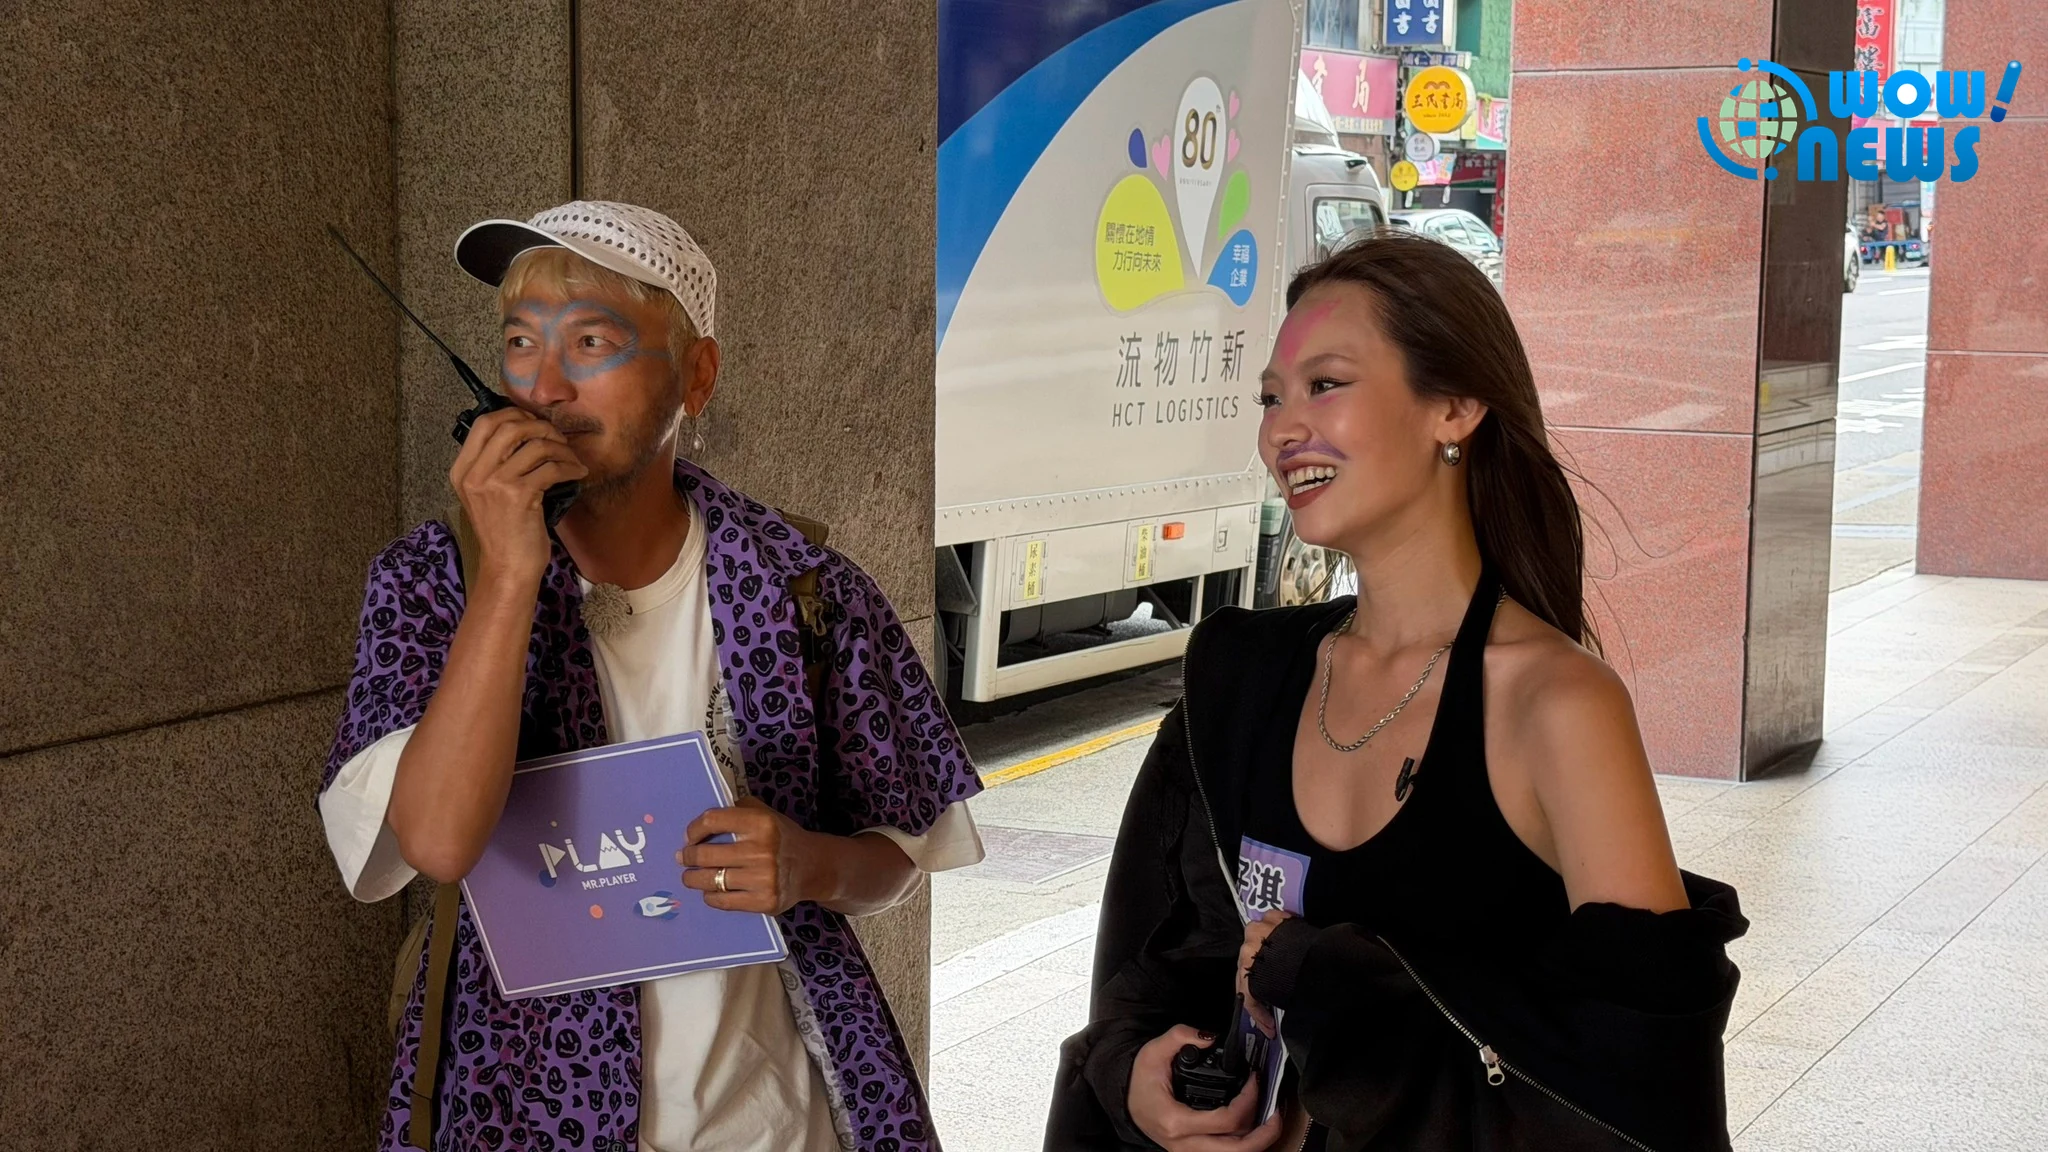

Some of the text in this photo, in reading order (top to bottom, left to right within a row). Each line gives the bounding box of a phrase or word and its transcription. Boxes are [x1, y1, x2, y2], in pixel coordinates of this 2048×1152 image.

[1411, 92, 1464, 110] 三民書局
[1105, 222, 1155, 247] 關懷在地情
[1112, 249, 1162, 272] 力行向未來
[1232, 244, 1250, 264] 幸福
[1229, 267, 1248, 287] 企業
[1111, 395, 1239, 428] HCT LOGISTICS
[538, 826, 647, 879] PLAY
[581, 872, 638, 890] MR.PLAYER
